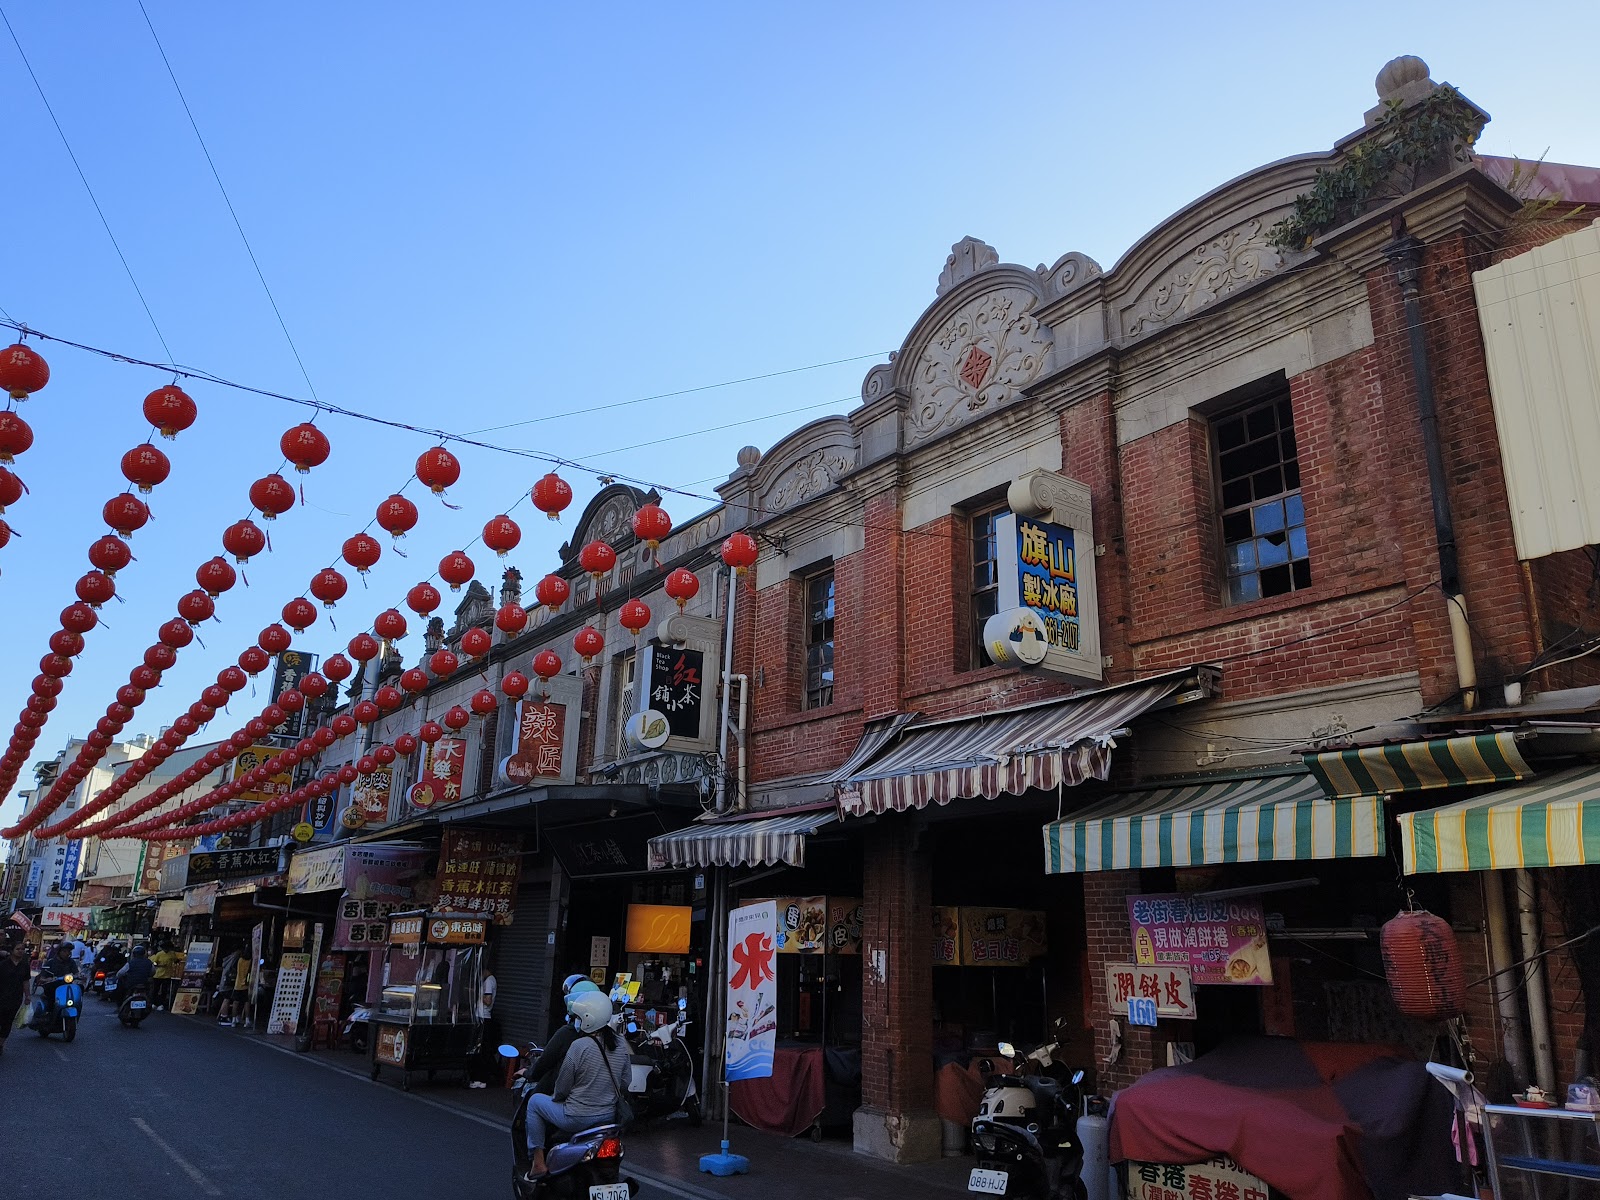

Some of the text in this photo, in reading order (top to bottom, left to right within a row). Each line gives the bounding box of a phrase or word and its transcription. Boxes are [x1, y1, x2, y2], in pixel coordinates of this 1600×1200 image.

[1020, 521, 1075, 583] 旗山
[1023, 573, 1077, 617] 製冰廠
[656, 652, 671, 660] Black
[522, 706, 560, 774] 辣匠
[441, 879, 513, 896] 香蕉冰紅茶
[437, 893, 510, 912] 珍珠鮮奶茶
[450, 921, 483, 933] 東品味
[1127, 998, 1156, 1025] 160
[1138, 1162, 1186, 1191] 春捲
